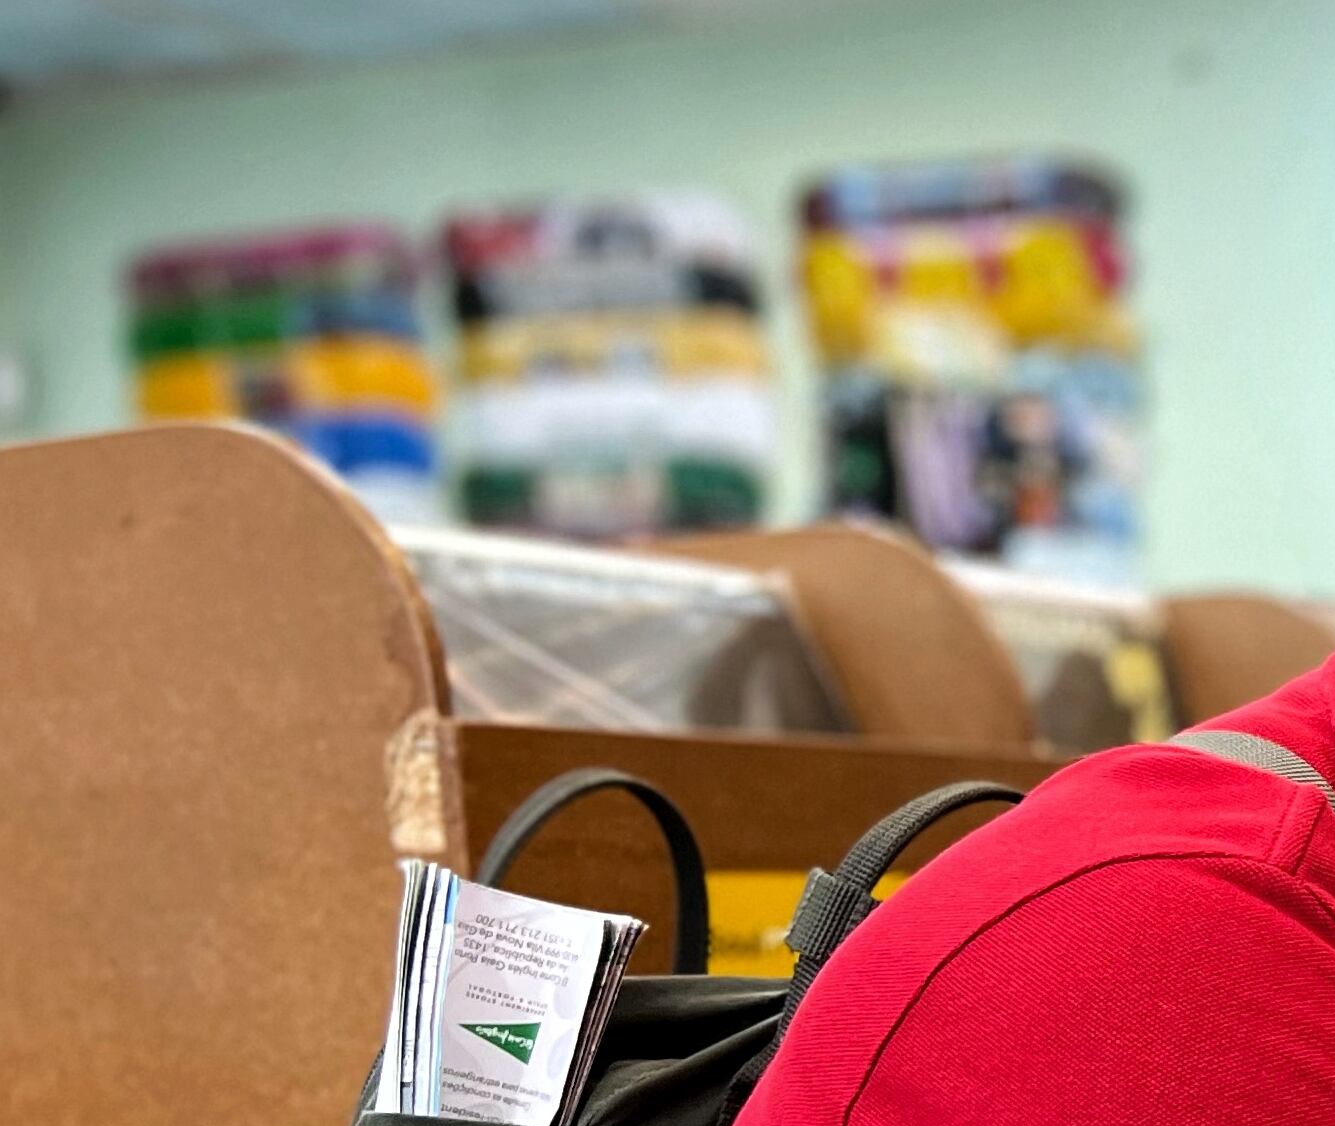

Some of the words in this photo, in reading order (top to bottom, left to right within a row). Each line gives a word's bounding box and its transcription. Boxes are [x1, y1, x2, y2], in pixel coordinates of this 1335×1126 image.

[475, 914, 496, 928] 700
[498, 920, 519, 934] 711
[479, 928, 494, 940] de
[521, 926, 542, 940] 213
[463, 937, 487, 953] 1435
[495, 933, 524, 949] Nova
[526, 941, 543, 954] Vila
[454, 948, 478, 963] Porto
[481, 955, 506, 971] Gaia
[546, 959, 557, 969] da
[508, 963, 539, 979] Inglés
[540, 972, 562, 986] Corte
[465, 991, 497, 1005] STORES
[468, 983, 515, 1002] PORTUGAL
[500, 1001, 546, 1017] DEPARTMENT
